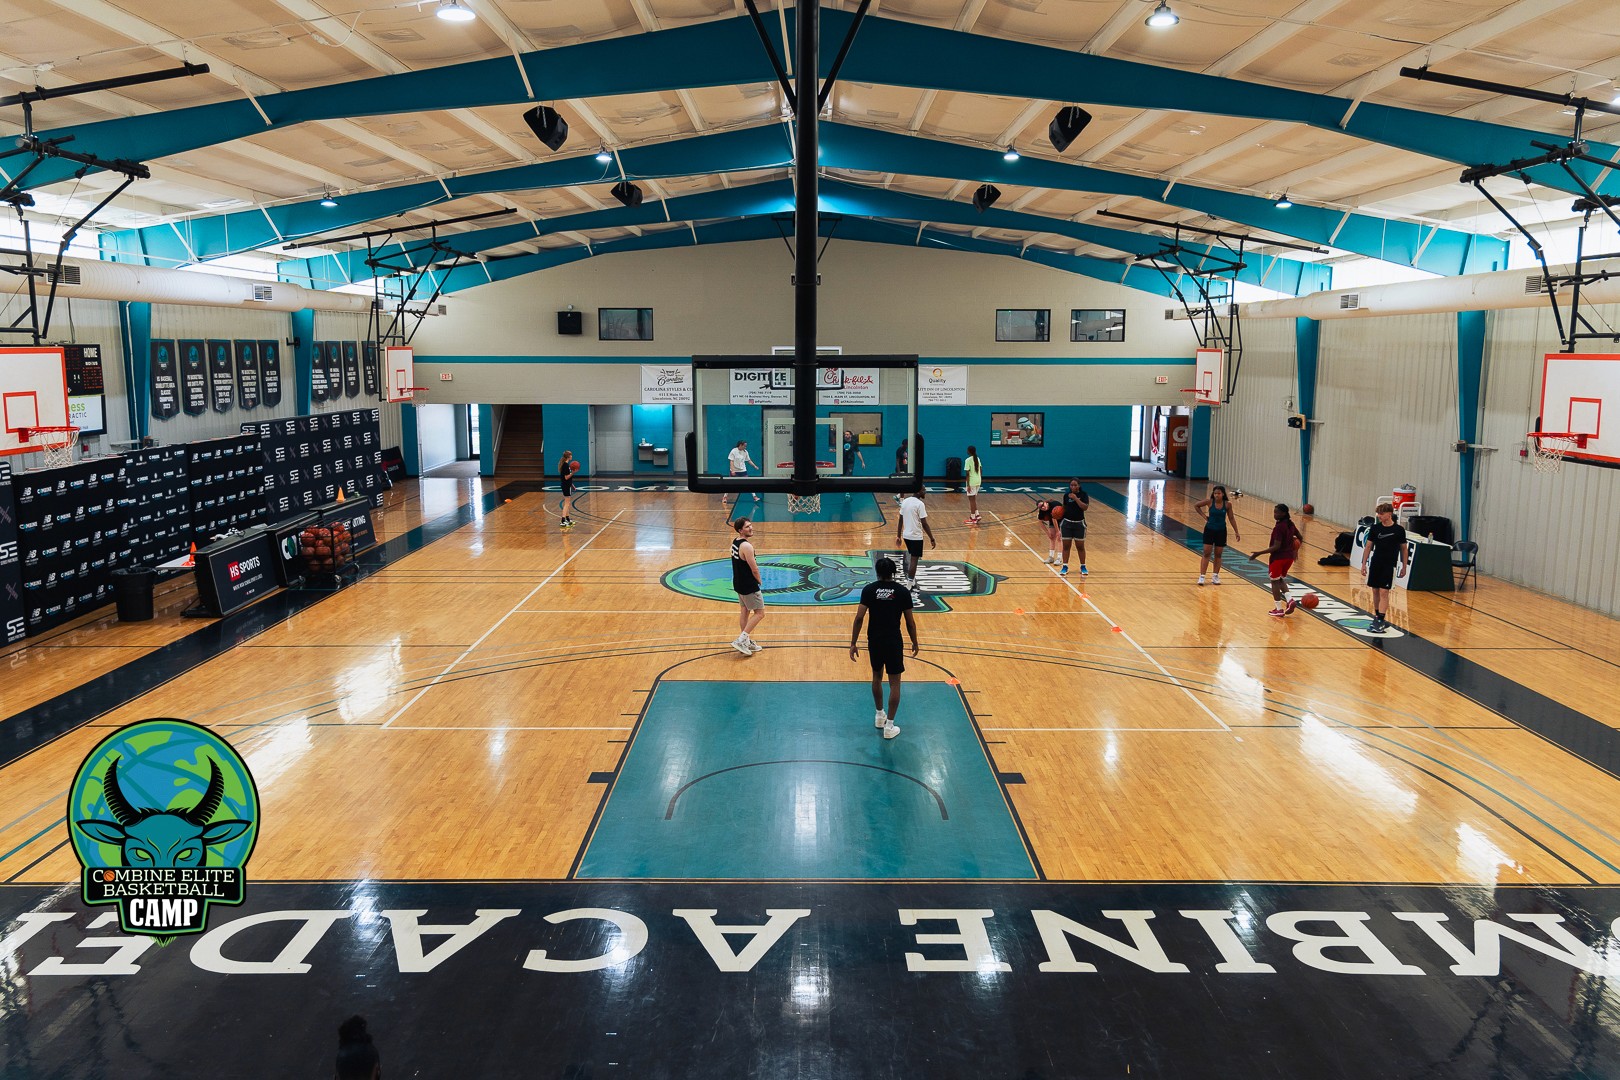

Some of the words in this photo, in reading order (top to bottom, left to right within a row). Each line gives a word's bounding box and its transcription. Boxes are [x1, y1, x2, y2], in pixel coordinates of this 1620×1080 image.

[84, 348, 97, 358] HOME
[734, 372, 786, 380] DIGITZE
[70, 403, 86, 412] ess
[230, 564, 240, 578] HS
[239, 556, 261, 573] SPORTS
[916, 565, 972, 592] GOATS
[7, 617, 24, 636] SE
[0, 908, 812, 976] ACADE
[898, 908, 1620, 976] MBINE
